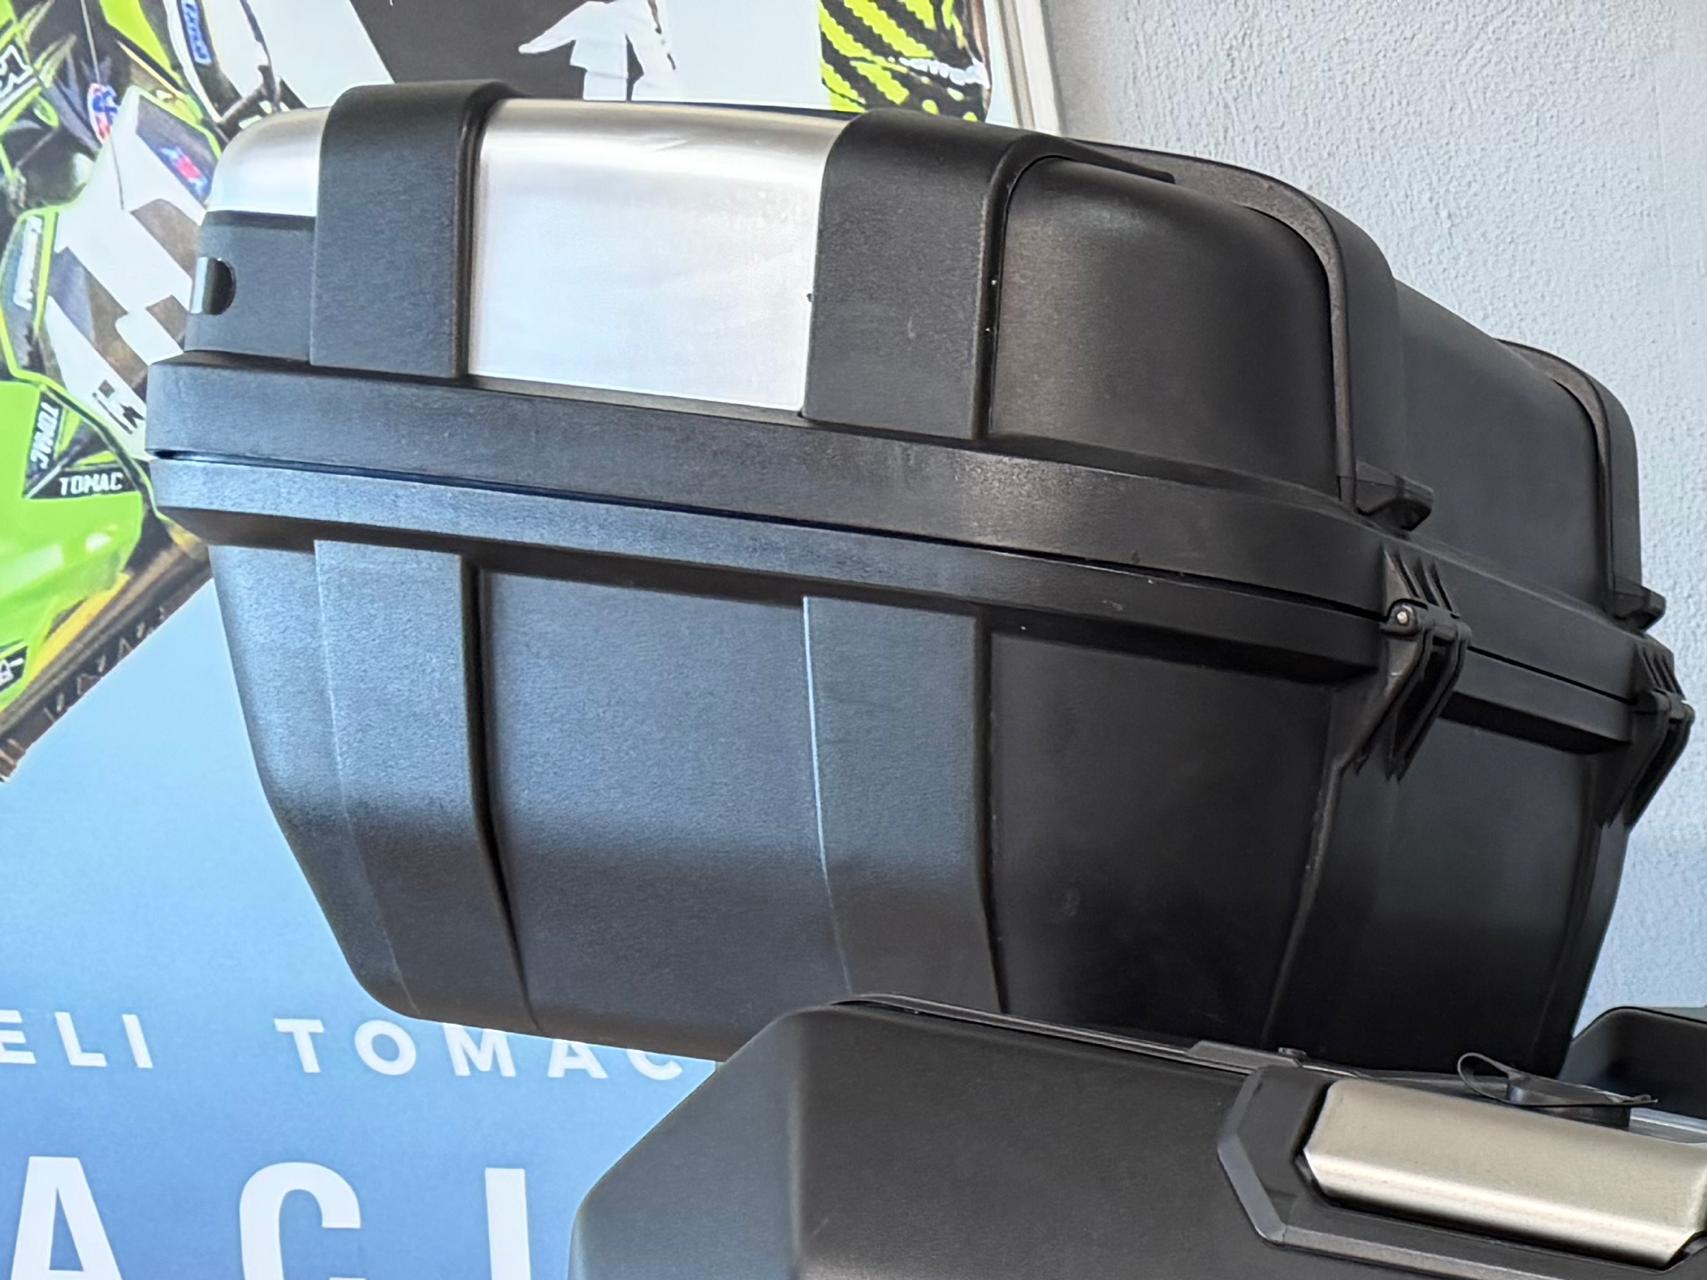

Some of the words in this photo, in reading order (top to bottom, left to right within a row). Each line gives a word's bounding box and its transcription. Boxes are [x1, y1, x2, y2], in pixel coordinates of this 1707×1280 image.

[59, 472, 124, 496] TOMAC
[0, 1009, 153, 1069] ELI
[274, 1018, 683, 1081] TOMAC
